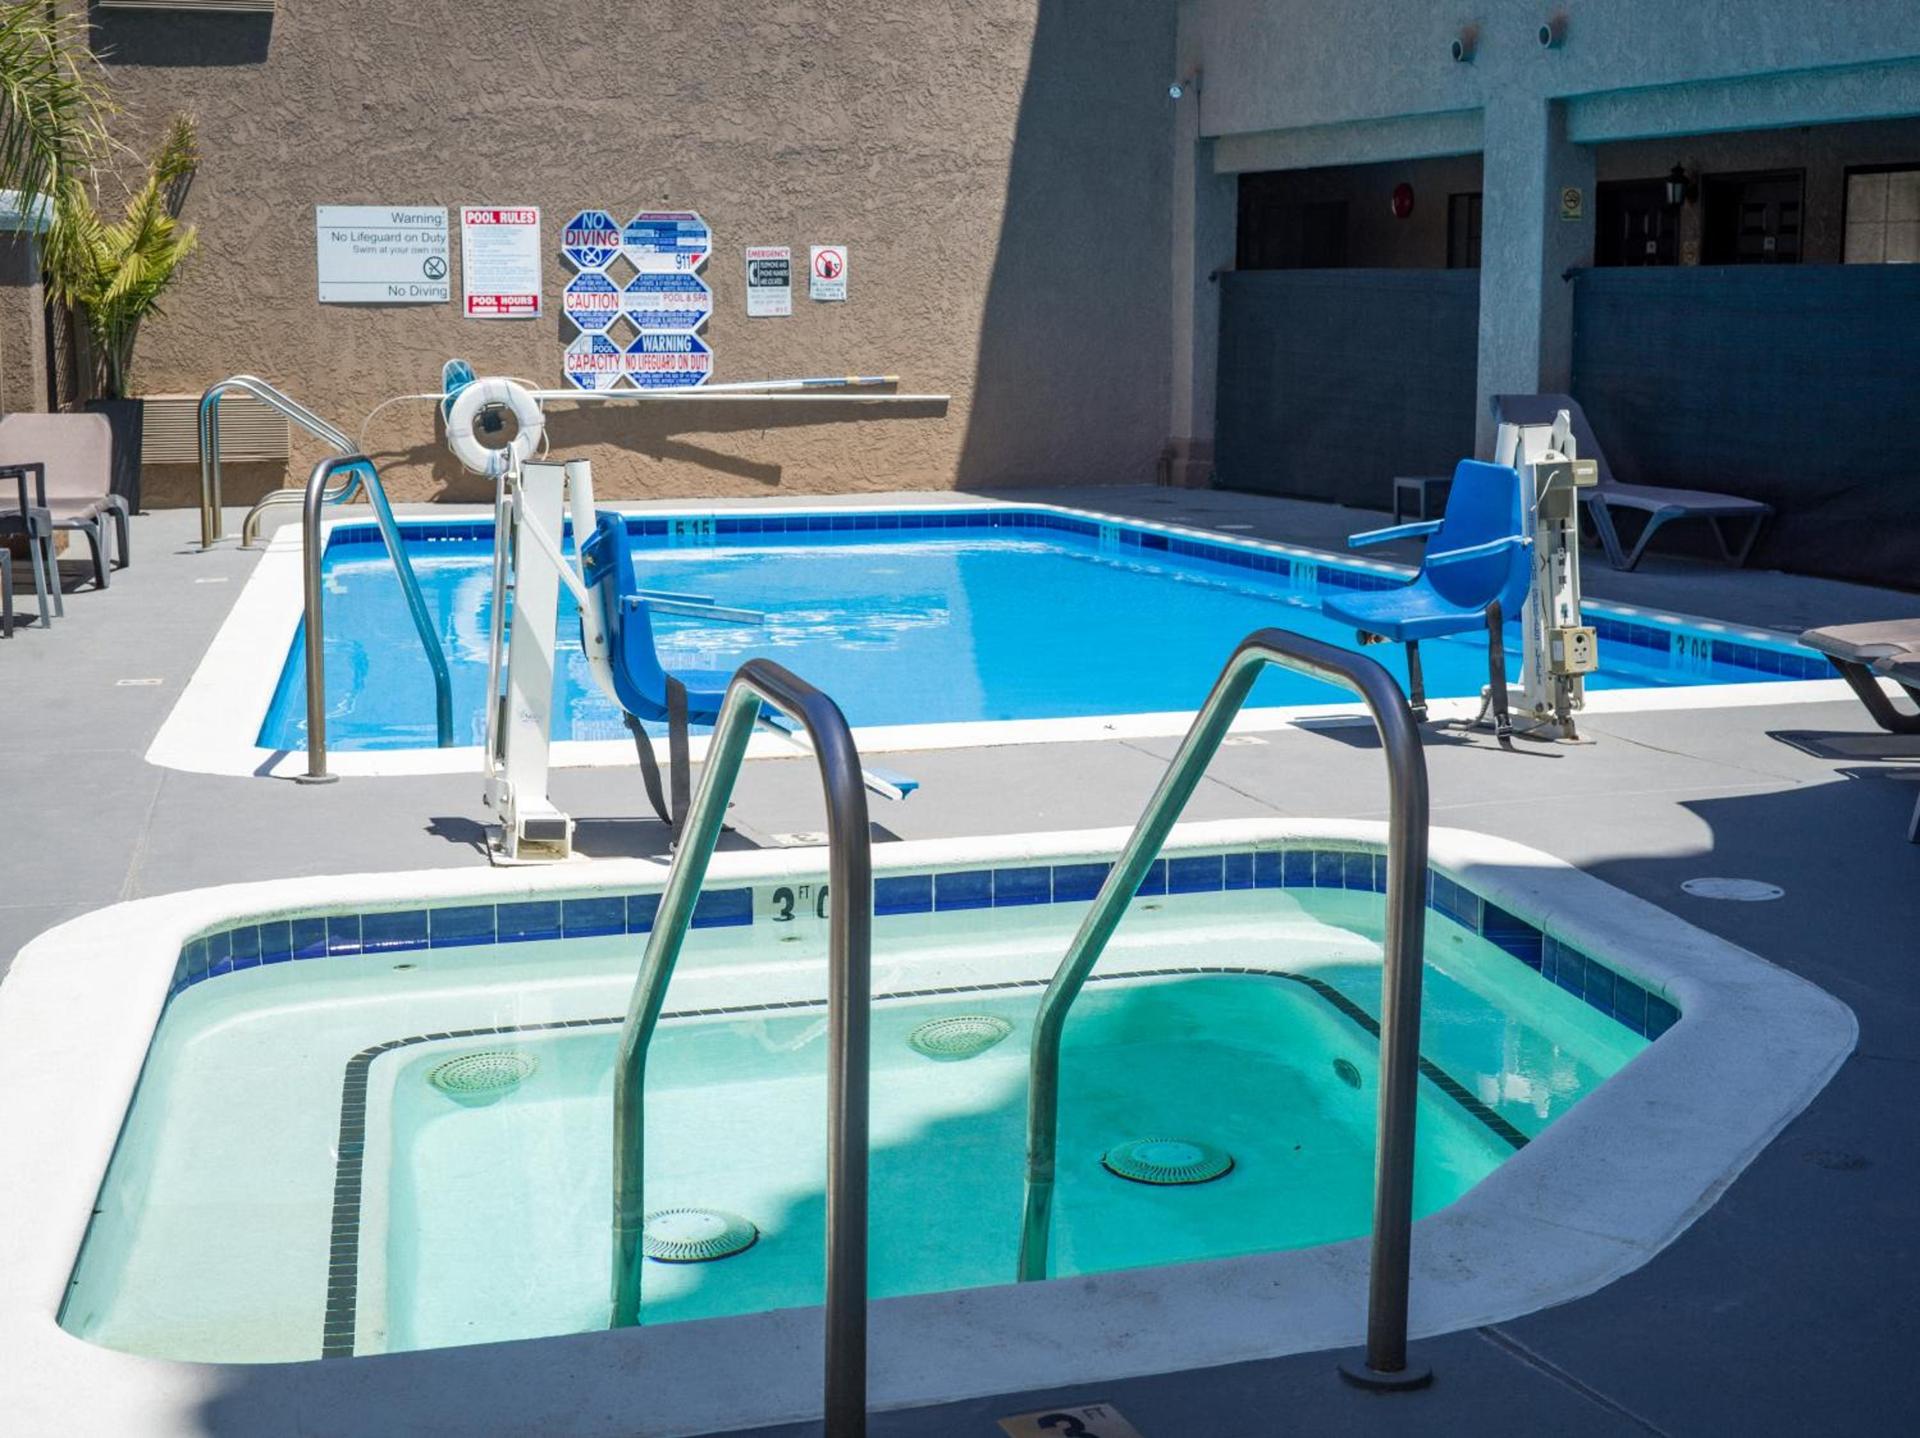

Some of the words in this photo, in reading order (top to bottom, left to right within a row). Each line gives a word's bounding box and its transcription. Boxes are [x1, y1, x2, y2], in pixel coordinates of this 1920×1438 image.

[391, 213, 442, 226] Warning
[466, 211, 496, 223] POOL
[500, 211, 535, 223] RULES
[582, 213, 604, 229] NO
[331, 232, 347, 242] No
[350, 231, 401, 244] Lifeguard
[404, 234, 418, 242] on
[421, 232, 446, 244] Duty
[565, 230, 619, 246] DIVING
[352, 245, 376, 254] Swim
[676, 254, 691, 269] 911
[388, 286, 405, 297] No
[409, 285, 447, 298] Diving
[472, 296, 498, 305] POOL
[501, 296, 533, 305] HOURS
[567, 293, 619, 309] CAUTION
[593, 345, 614, 353] POOL
[642, 335, 692, 352] WARNING
[568, 353, 620, 370] CAPACITY
[626, 354, 637, 370] NO
[639, 354, 675, 370] LIFEGUARD
[679, 354, 688, 370] ON
[691, 354, 709, 370] DUTY
[772, 887, 795, 921] 3
[799, 885, 810, 899] FT
